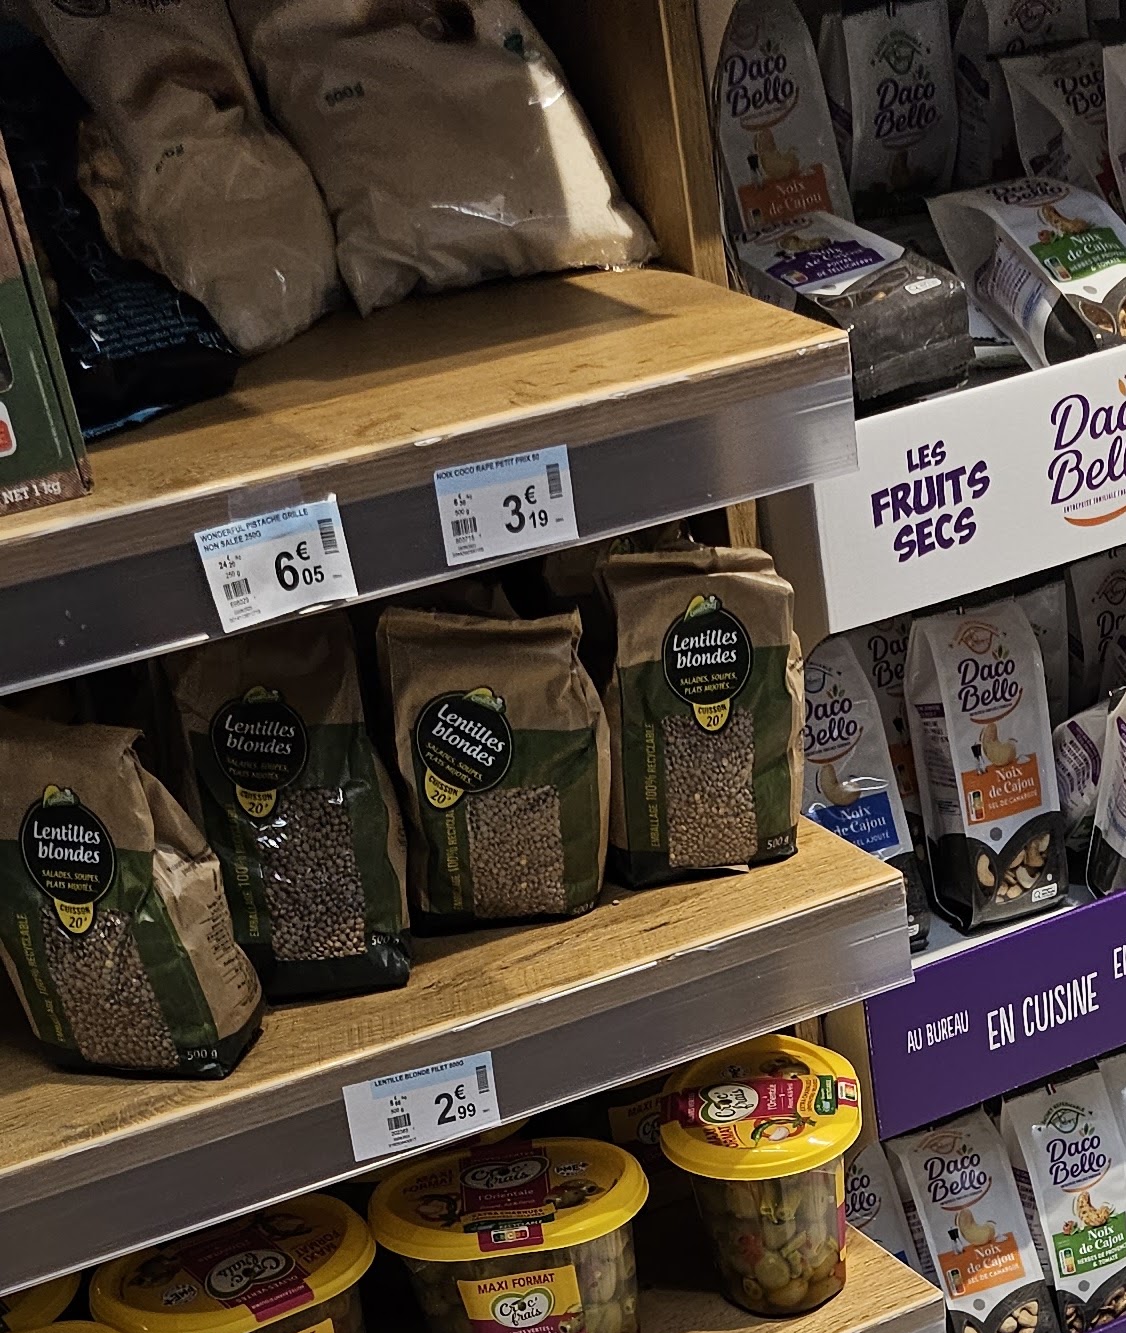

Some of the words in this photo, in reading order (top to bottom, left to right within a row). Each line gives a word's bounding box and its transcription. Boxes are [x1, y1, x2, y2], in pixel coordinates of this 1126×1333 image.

[454, 467, 474, 478] COCO
[476, 463, 494, 475] RAPE
[496, 458, 514, 472] PETIT
[515, 455, 530, 467] PRIX
[907, 440, 946, 472] LES
[3, 487, 30, 504] NET
[31, 484, 38, 495] 1
[42, 480, 61, 496] kg
[871, 459, 990, 529] FRUITS
[200, 523, 245, 543] WONDERFUL
[246, 515, 281, 532] PISTACHE
[282, 508, 308, 523] GRILLE
[894, 506, 977, 563] SECS
[204, 543, 218, 553] NON
[219, 536, 243, 549] SALEE
[673, 629, 738, 651] Lentilles
[676, 648, 737, 669] blondes
[698, 703, 727, 714] CUISSON
[224, 714, 296, 738] Lentilles
[437, 703, 506, 753] Lentilles
[226, 733, 292, 755] blondes
[432, 722, 495, 768] blondes
[428, 775, 459, 796] CUISSON
[33, 821, 100, 845] Lentilles
[767, 838, 782, 850] 500
[37, 841, 100, 864] blondes
[59, 904, 91, 915] CUISSON
[987, 1010, 1016, 1051] EN
[1023, 972, 1100, 1037] CUISINE
[907, 1025, 923, 1054] AU
[927, 1010, 969, 1047] BUREAU
[187, 1050, 207, 1060] 500
[374, 1074, 403, 1087] LENTILLE
[404, 1069, 430, 1080] BLONDE
[431, 1064, 448, 1073] FILET
[1046, 1135, 1101, 1162] Daco
[924, 1153, 981, 1181] Daco
[1050, 1152, 1106, 1186] Bello
[928, 1170, 987, 1203] Bello
[1079, 1243, 1093, 1256] de
[1094, 1232, 1125, 1252] Cajou
[1087, 1224, 1114, 1241] Noix
[477, 1280, 509, 1295] MAXI
[512, 1273, 555, 1289] FORMAT
[512, 1308, 542, 1326] frais
[527, 1325, 550, 1333] VERTES
